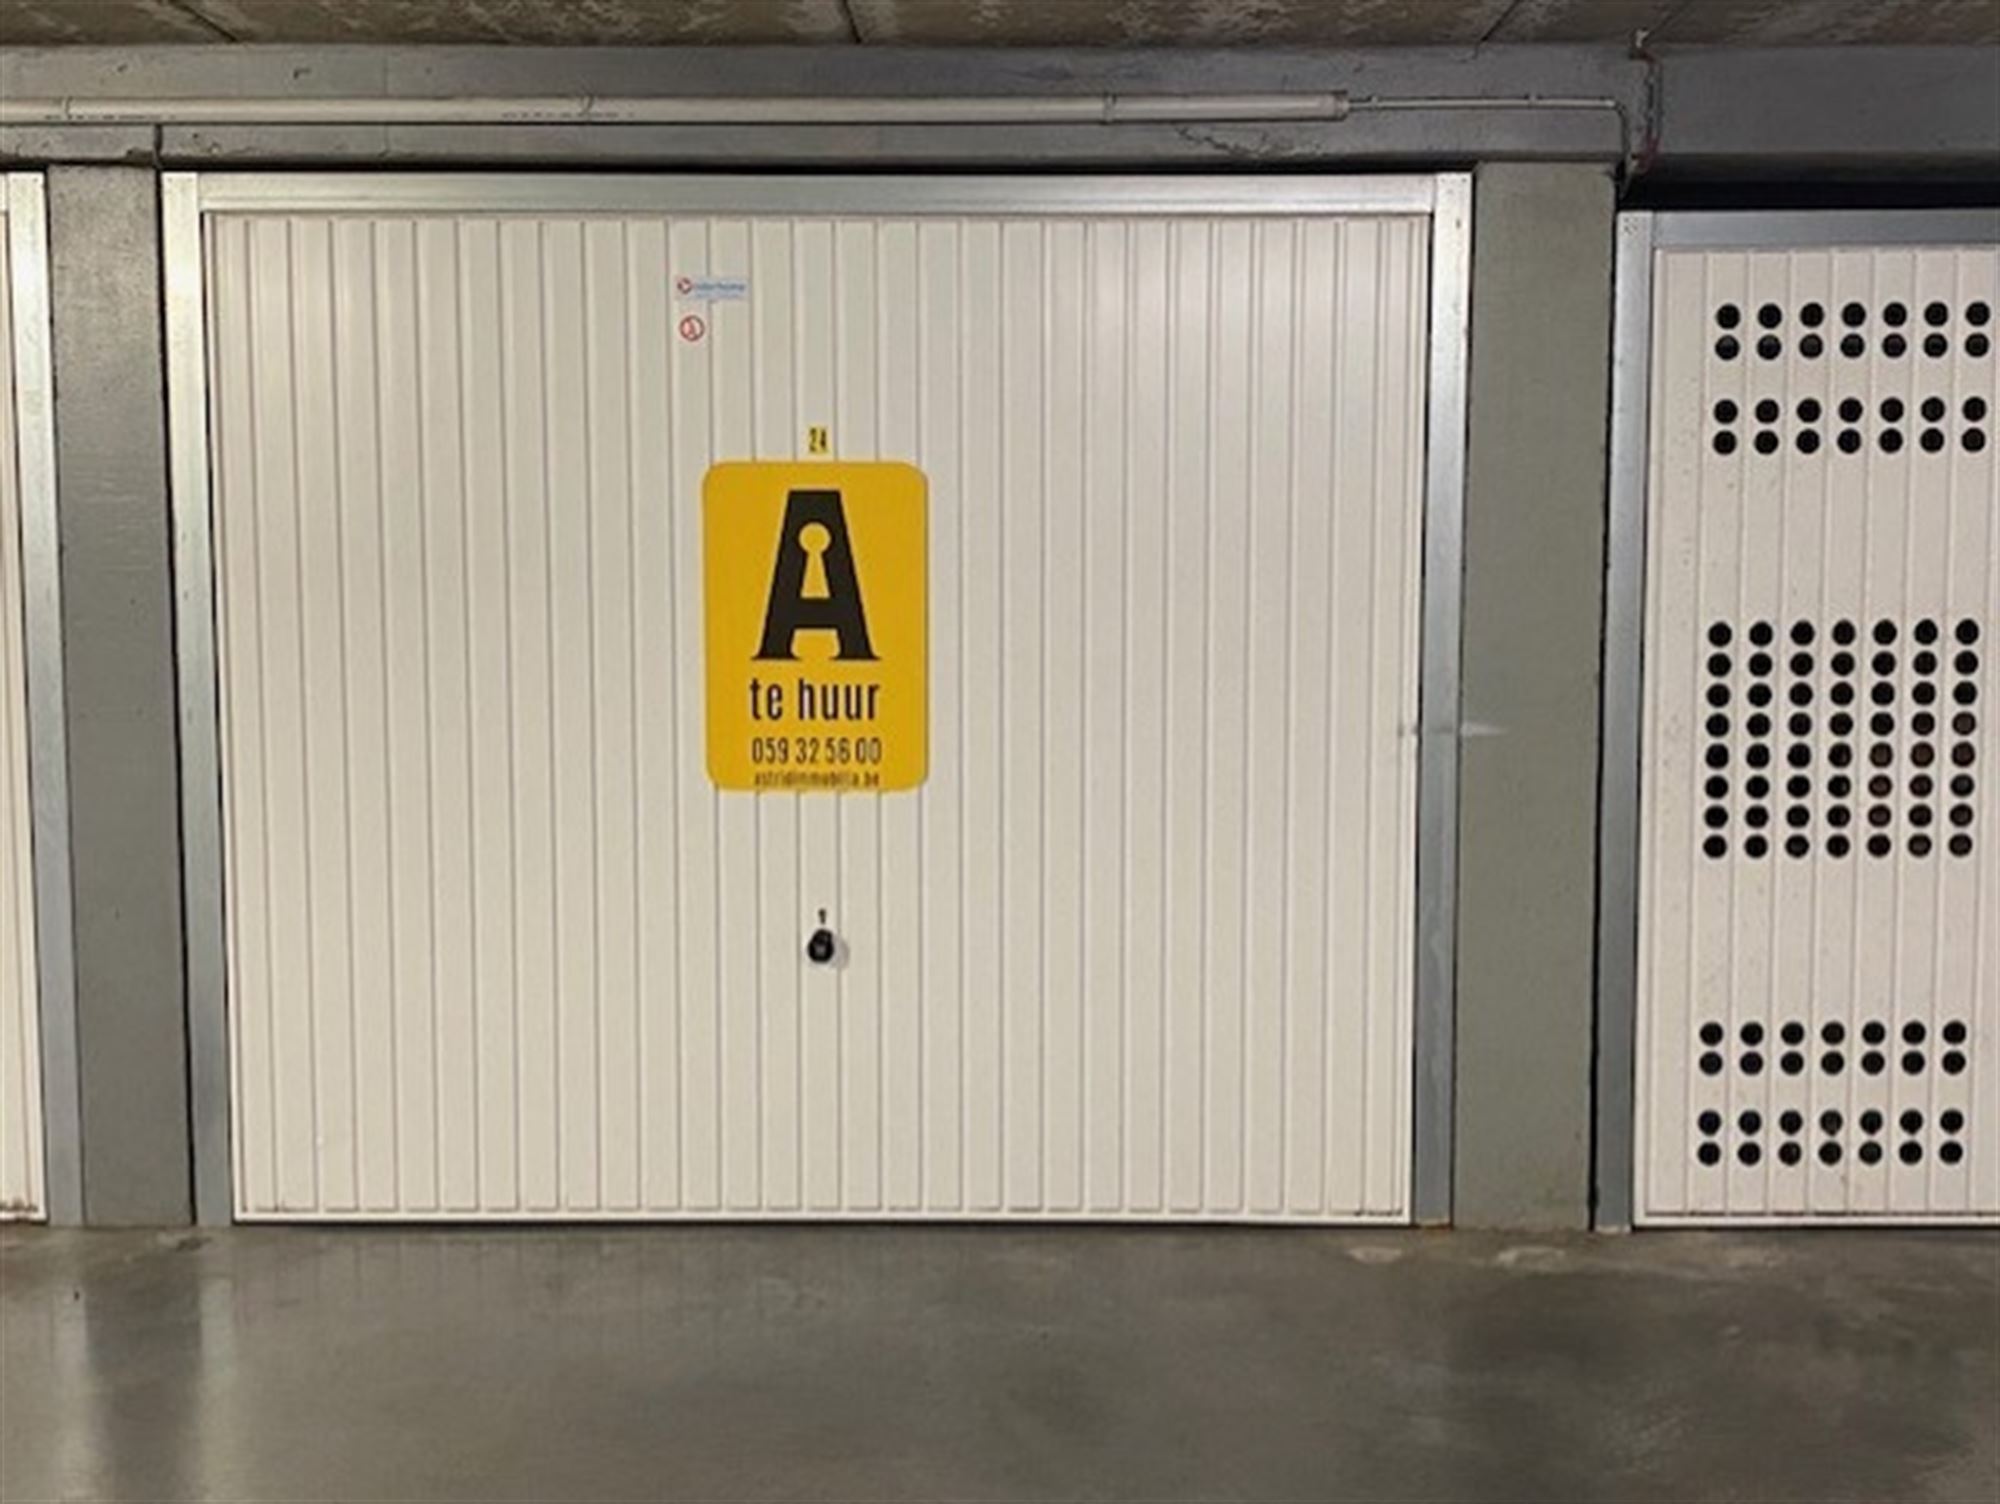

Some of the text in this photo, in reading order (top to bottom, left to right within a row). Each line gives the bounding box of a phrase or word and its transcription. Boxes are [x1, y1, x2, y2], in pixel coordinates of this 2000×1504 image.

[752, 489, 880, 661] A
[750, 678, 880, 720] te huur
[752, 737, 882, 764] 059 32 56 00
